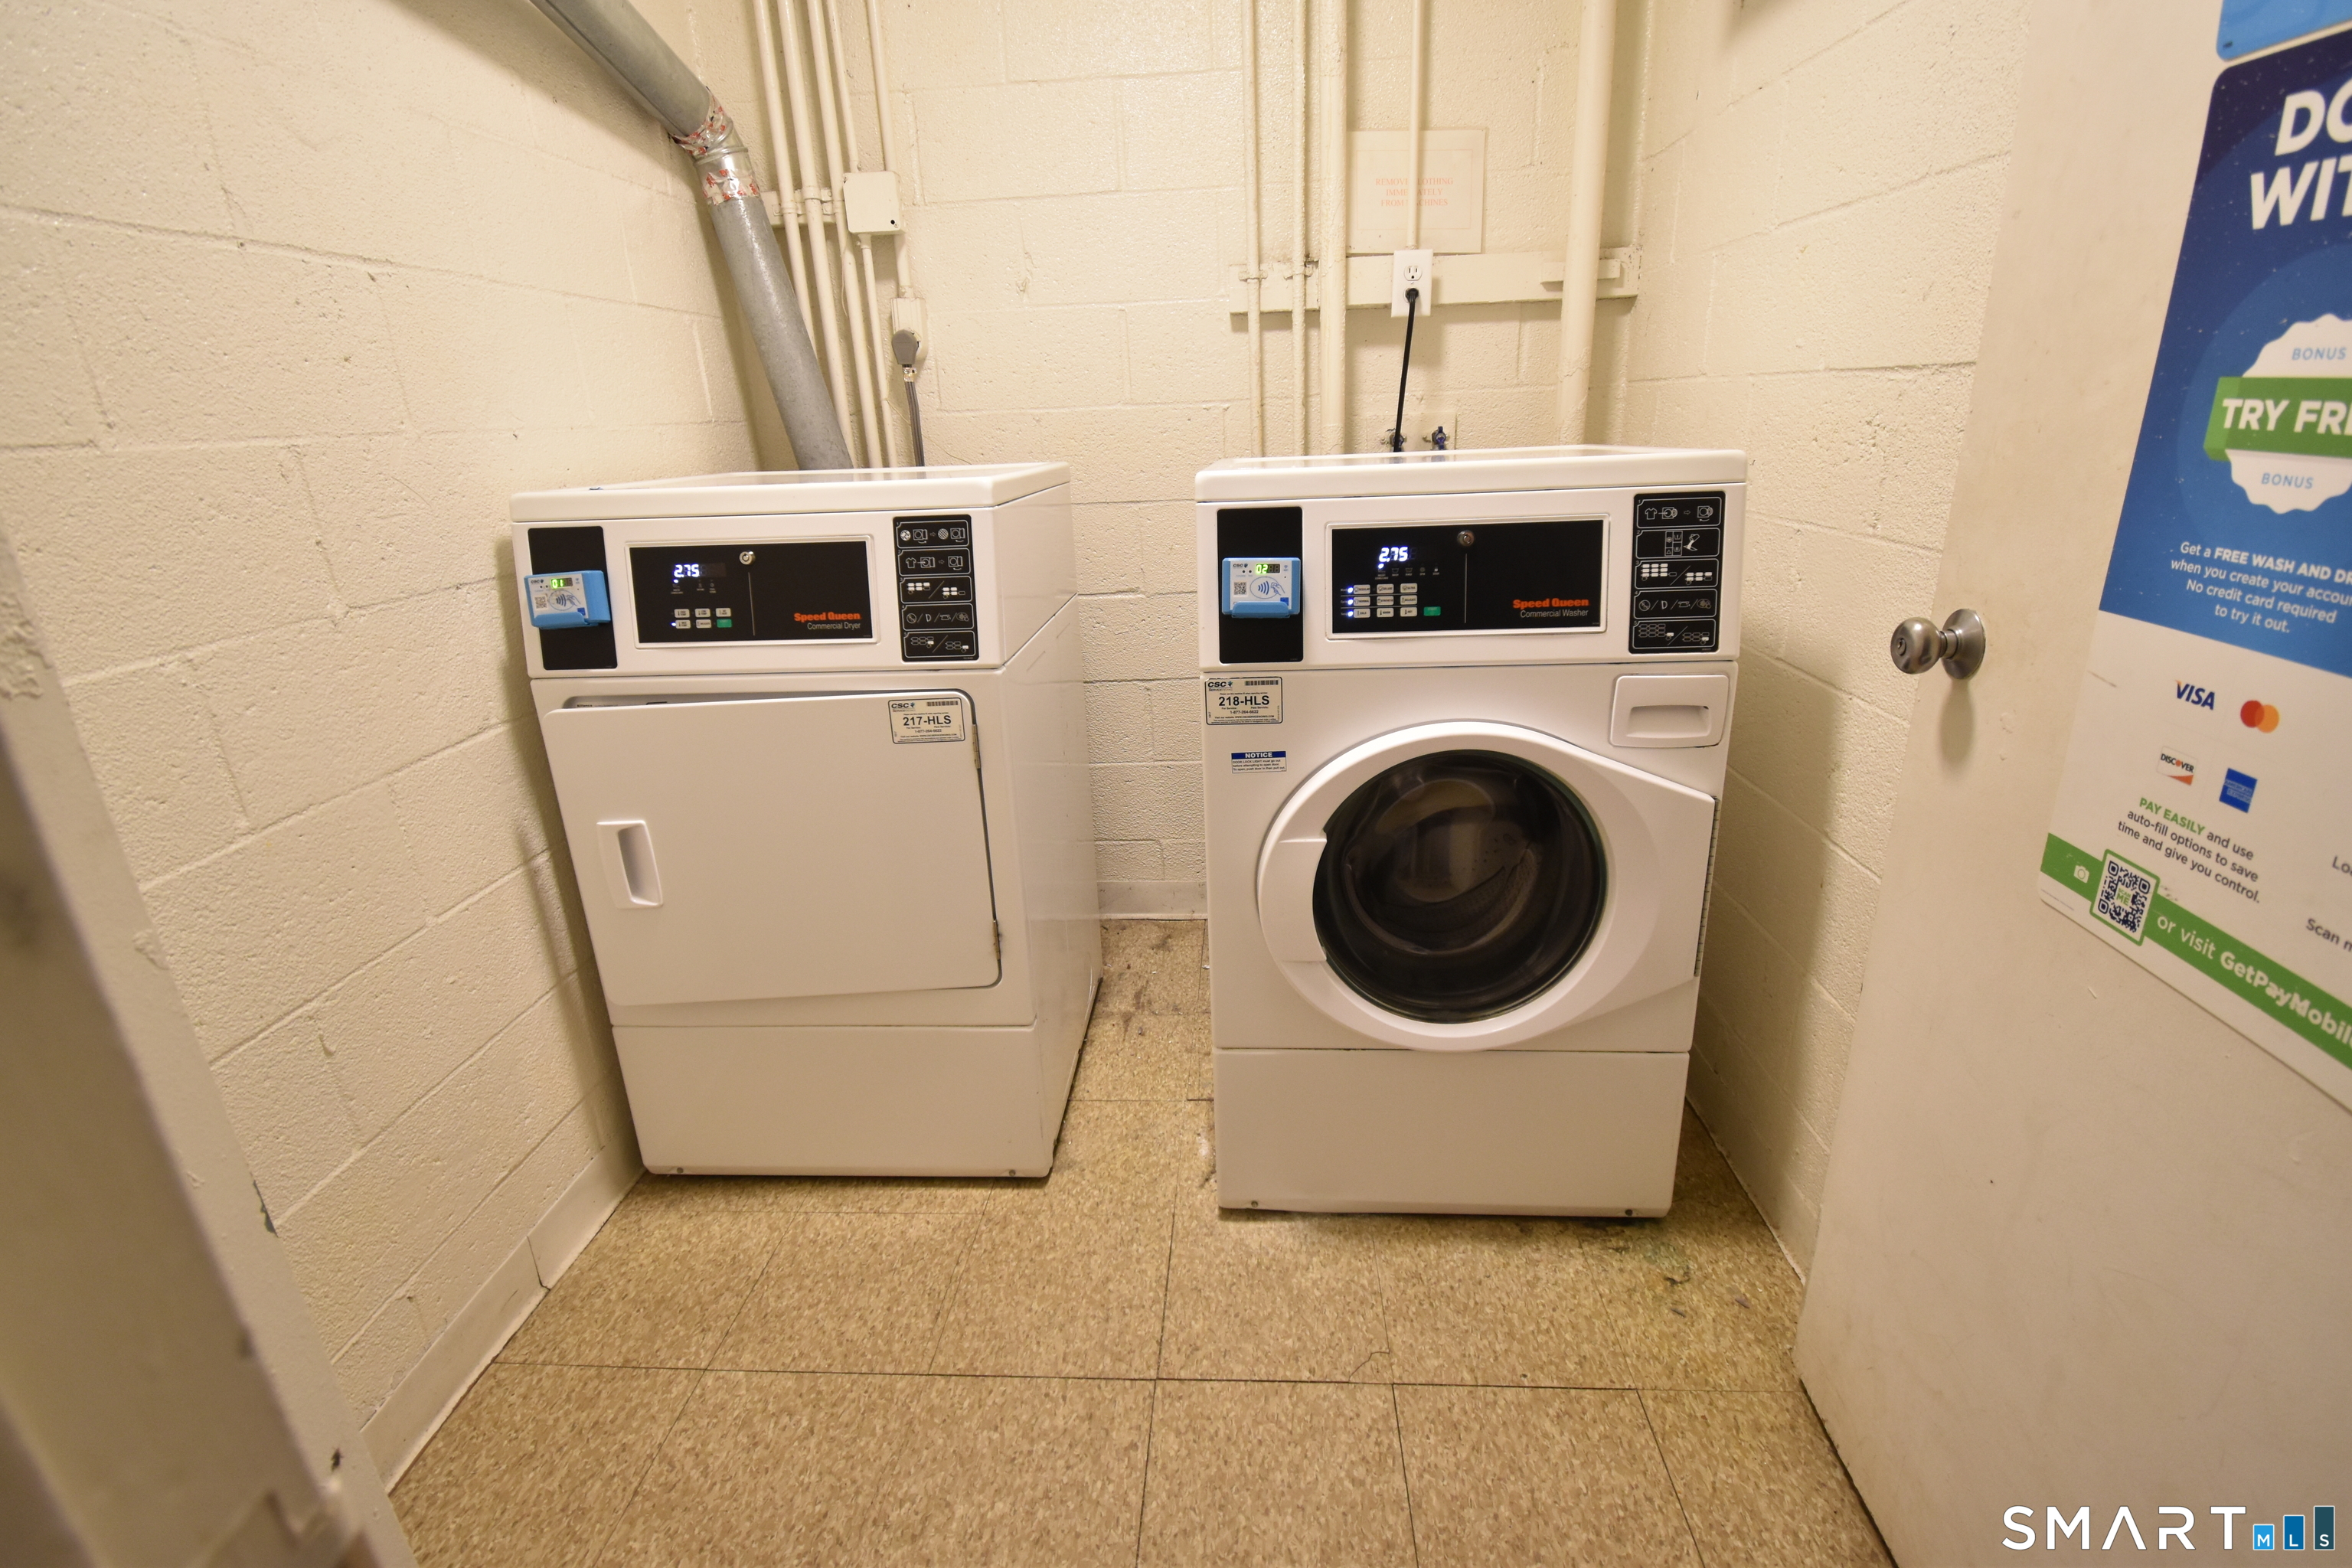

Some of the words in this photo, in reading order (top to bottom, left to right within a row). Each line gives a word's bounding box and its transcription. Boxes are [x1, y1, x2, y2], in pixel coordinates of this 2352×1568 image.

[1406, 198, 1449, 207] CHINES
[2292, 347, 2347, 361] BONUS
[2222, 397, 2290, 432] TRY
[2294, 400, 2352, 436] FR
[2261, 472, 2314, 489] BONUS
[1256, 564, 1268, 574] 02
[2180, 541, 2201, 557] Get
[2203, 548, 2211, 557] a
[2214, 547, 2249, 564] FREE
[2252, 554, 2295, 573] WASH
[2297, 563, 2332, 580] AND
[2171, 559, 2201, 574] when
[2203, 566, 2226, 579] you
[2230, 571, 2269, 589] create
[2272, 580, 2304, 596] your
[2306, 586, 2352, 606] accou
[1513, 598, 1550, 610] Speed
[1552, 597, 1589, 607] Queen
[2186, 579, 2203, 593] No
[2207, 584, 2243, 602] credit
[2245, 593, 2275, 609] card
[2277, 600, 2337, 624] required
[794, 612, 826, 622] Speed
[828, 612, 861, 620] Queen
[1521, 609, 1561, 618] Commercial
[1562, 609, 1589, 617] Washer
[2215, 604, 2228, 617] to
[2230, 608, 2249, 625] try
[2252, 612, 2261, 626] it
[2264, 616, 2290, 633] out.
[844, 622, 861, 630] Dryer
[1219, 695, 1269, 706] 218-HLS
[2175, 679, 2215, 710] VISA
[903, 715, 952, 726] 217-HLS
[2161, 753, 2194, 773] DISCOVER
[2139, 797, 2161, 815] PAY
[2163, 808, 2206, 835] EASILY
[2207, 831, 2230, 848] and
[2233, 843, 2254, 861] use
[2127, 810, 2168, 837] auto-fill
[2171, 831, 2212, 859] options
[2216, 853, 2228, 866] to
[2230, 862, 2259, 882] save
[2118, 821, 2140, 840] time
[2142, 835, 2163, 851] and
[2164, 847, 2188, 864] give
[2190, 859, 2212, 877] you
[2214, 873, 2259, 903] control.
[2332, 855, 2352, 877] Lo
[2116, 893, 2130, 906] ME
[2118, 887, 2132, 898] SCAN
[2306, 918, 2340, 945] Scan
[2157, 916, 2176, 933] or
[2181, 928, 2216, 959] visit
[2220, 951, 2352, 1050] GetPayMobil
